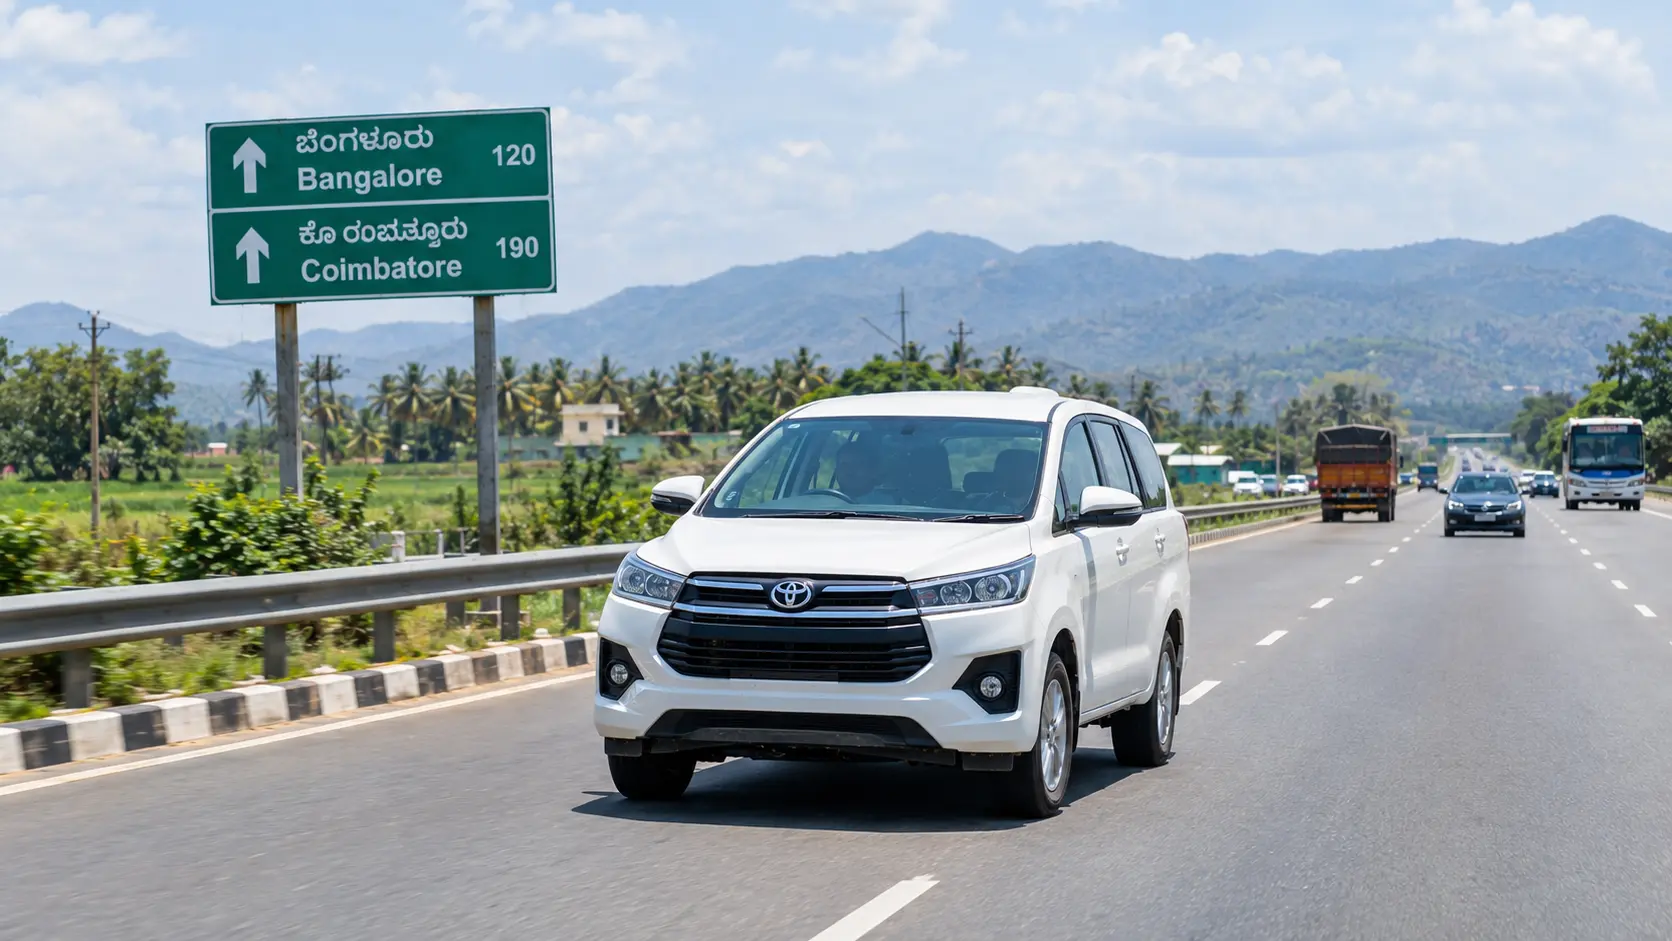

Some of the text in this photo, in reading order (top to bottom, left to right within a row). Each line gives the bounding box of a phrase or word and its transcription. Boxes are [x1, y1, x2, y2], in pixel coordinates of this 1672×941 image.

[296, 124, 434, 153] ಬೆಂಗಳೂರು
[492, 144, 536, 166] 120
[297, 164, 443, 194] Bangalore
[496, 236, 539, 259] 190
[301, 256, 462, 283] Coimbatore
